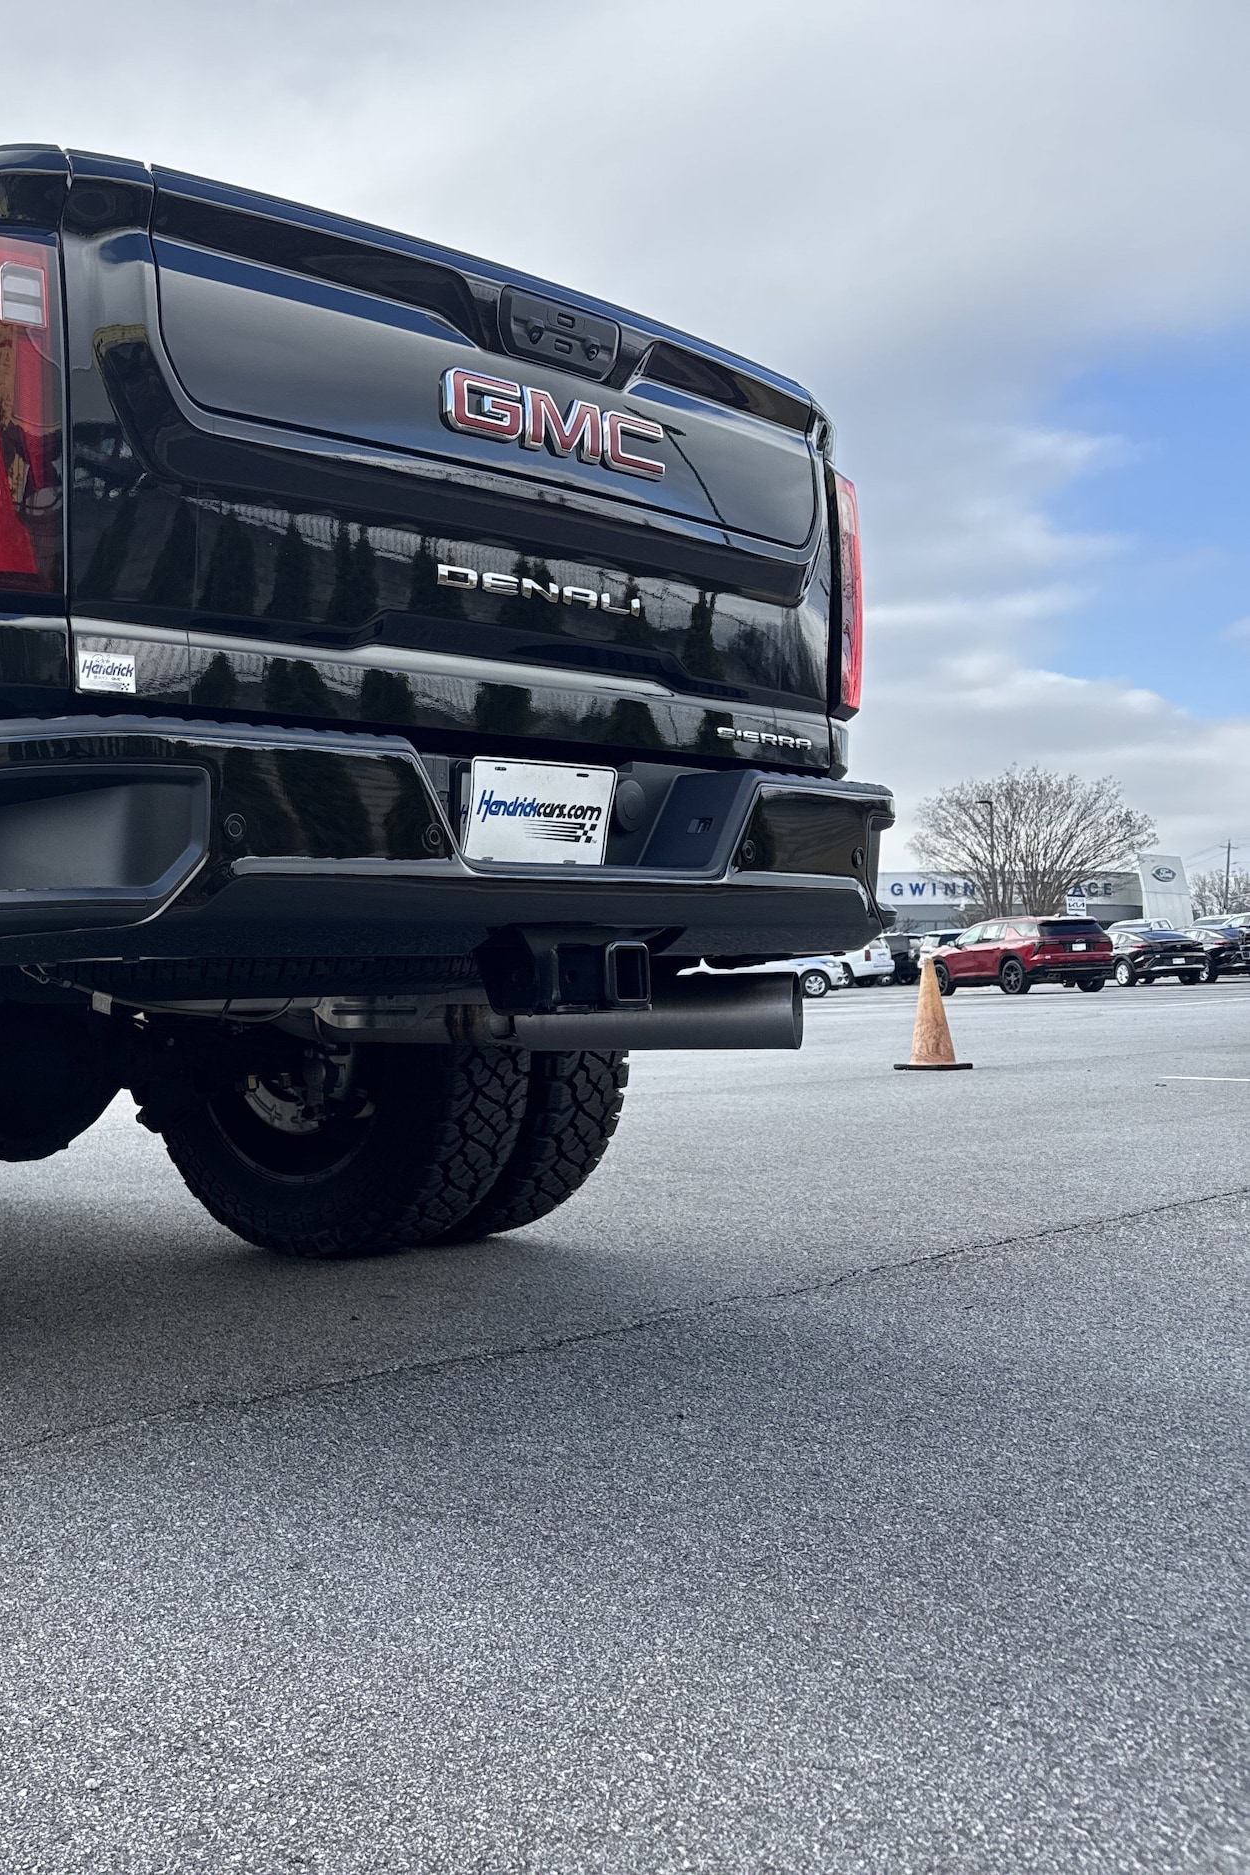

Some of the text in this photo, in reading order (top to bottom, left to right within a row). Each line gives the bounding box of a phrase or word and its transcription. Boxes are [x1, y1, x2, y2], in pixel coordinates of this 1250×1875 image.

[440, 366, 665, 482] GMC
[437, 564, 640, 617] DENALI
[81, 659, 134, 678] Hendrick
[716, 726, 812, 750] SIERRA
[476, 789, 602, 822] Hendrickcars.com
